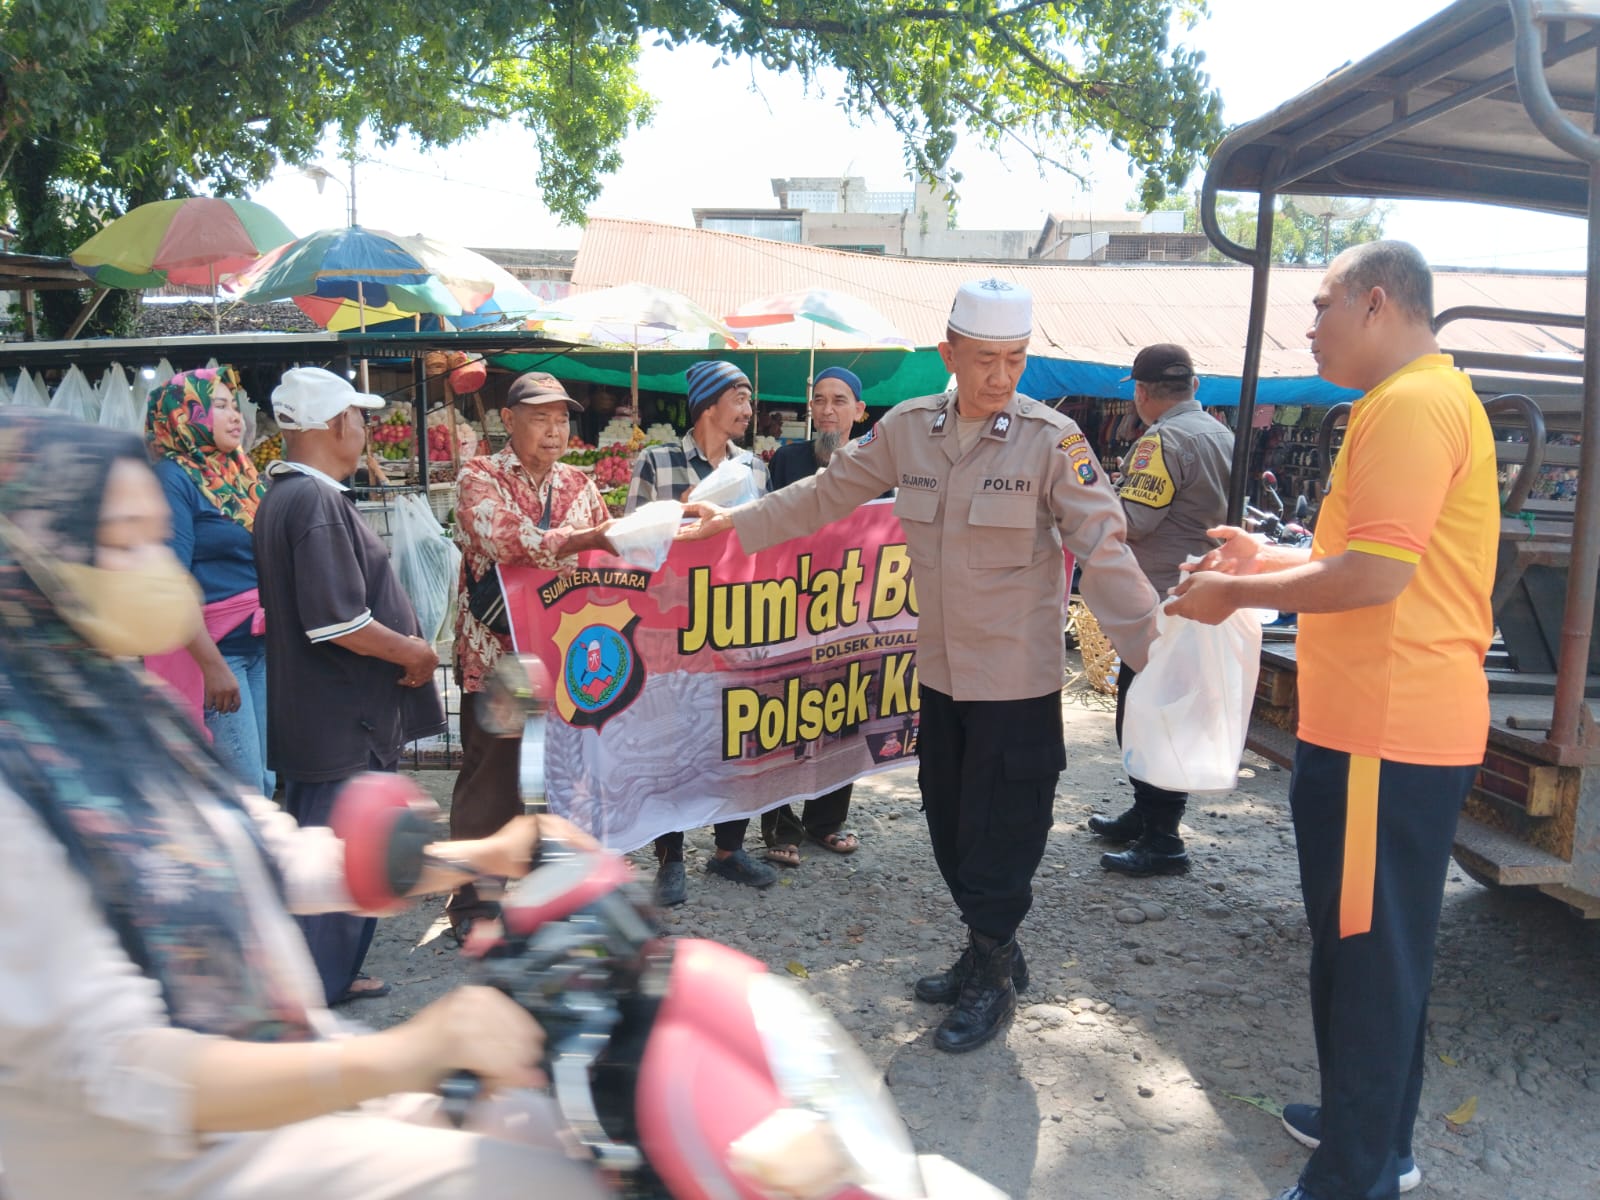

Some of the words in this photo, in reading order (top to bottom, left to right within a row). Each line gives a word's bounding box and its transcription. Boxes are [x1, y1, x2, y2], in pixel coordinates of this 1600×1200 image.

[983, 478, 1031, 492] POLRI
[1132, 488, 1158, 502] KUALA
[542, 571, 601, 604] SUMATERA
[603, 571, 646, 589] UTARA
[678, 545, 863, 655] Jum'at
[815, 638, 870, 661] POLSEK
[874, 633, 918, 648] KUAL
[722, 662, 874, 761] Polsek
